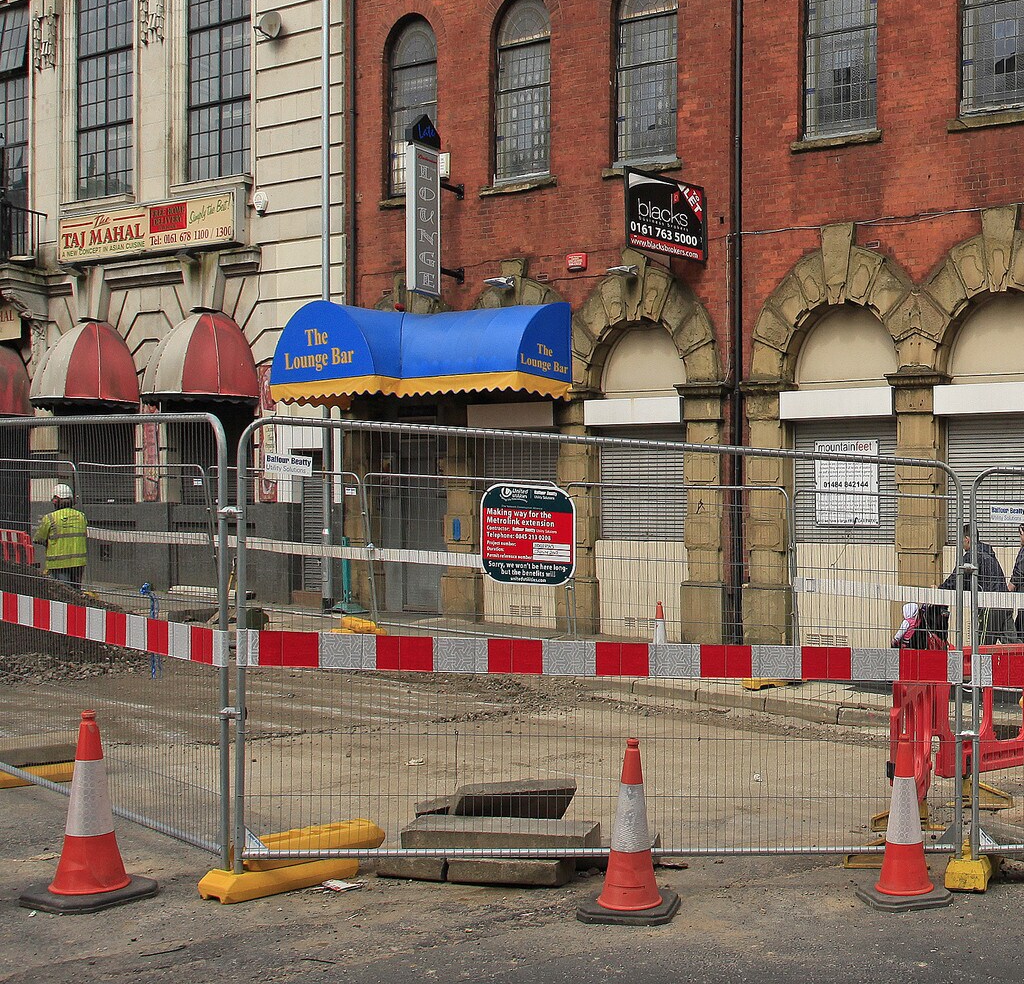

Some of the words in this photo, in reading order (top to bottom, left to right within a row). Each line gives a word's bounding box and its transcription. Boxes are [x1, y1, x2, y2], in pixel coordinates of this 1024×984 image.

[418, 123, 435, 139] Late
[684, 188, 702, 213] LET
[189, 205, 206, 224] Simply
[638, 193, 688, 227] blacks
[93, 215, 110, 229] The
[417, 164, 437, 289] LOUNGE
[62, 230, 85, 249] TAJ
[89, 223, 145, 246] MAHAL
[150, 236, 162, 246] Tel:
[163, 233, 177, 243] 0161
[179, 231, 192, 241] 678
[194, 228, 209, 239] 1100
[630, 221, 653, 236] 0161
[655, 227, 672, 240] 763
[675, 232, 698, 246] 5000
[67, 249, 78, 257] NEW
[79, 247, 101, 255] CONCEPT
[109, 244, 125, 252] ASIAN
[126, 241, 145, 249] CUISINE
[630, 237, 699, 259] www.blacksbrokers.com
[304, 328, 328, 347] The
[284, 350, 329, 372] Lounge
[331, 346, 354, 365] Bar
[537, 343, 553, 357] The
[520, 353, 551, 372] Lounge
[553, 362, 569, 375] Bar
[818, 441, 872, 452] mountainfeet
[266, 455, 289, 464] Balfour
[291, 457, 311, 467] Beatty
[266, 464, 282, 472] Utility
[283, 466, 307, 474] Solutions
[486, 507, 512, 518] Making
[513, 511, 528, 519] way
[486, 516, 520, 525] Metrolink
[488, 561, 505, 569] Sorry,
